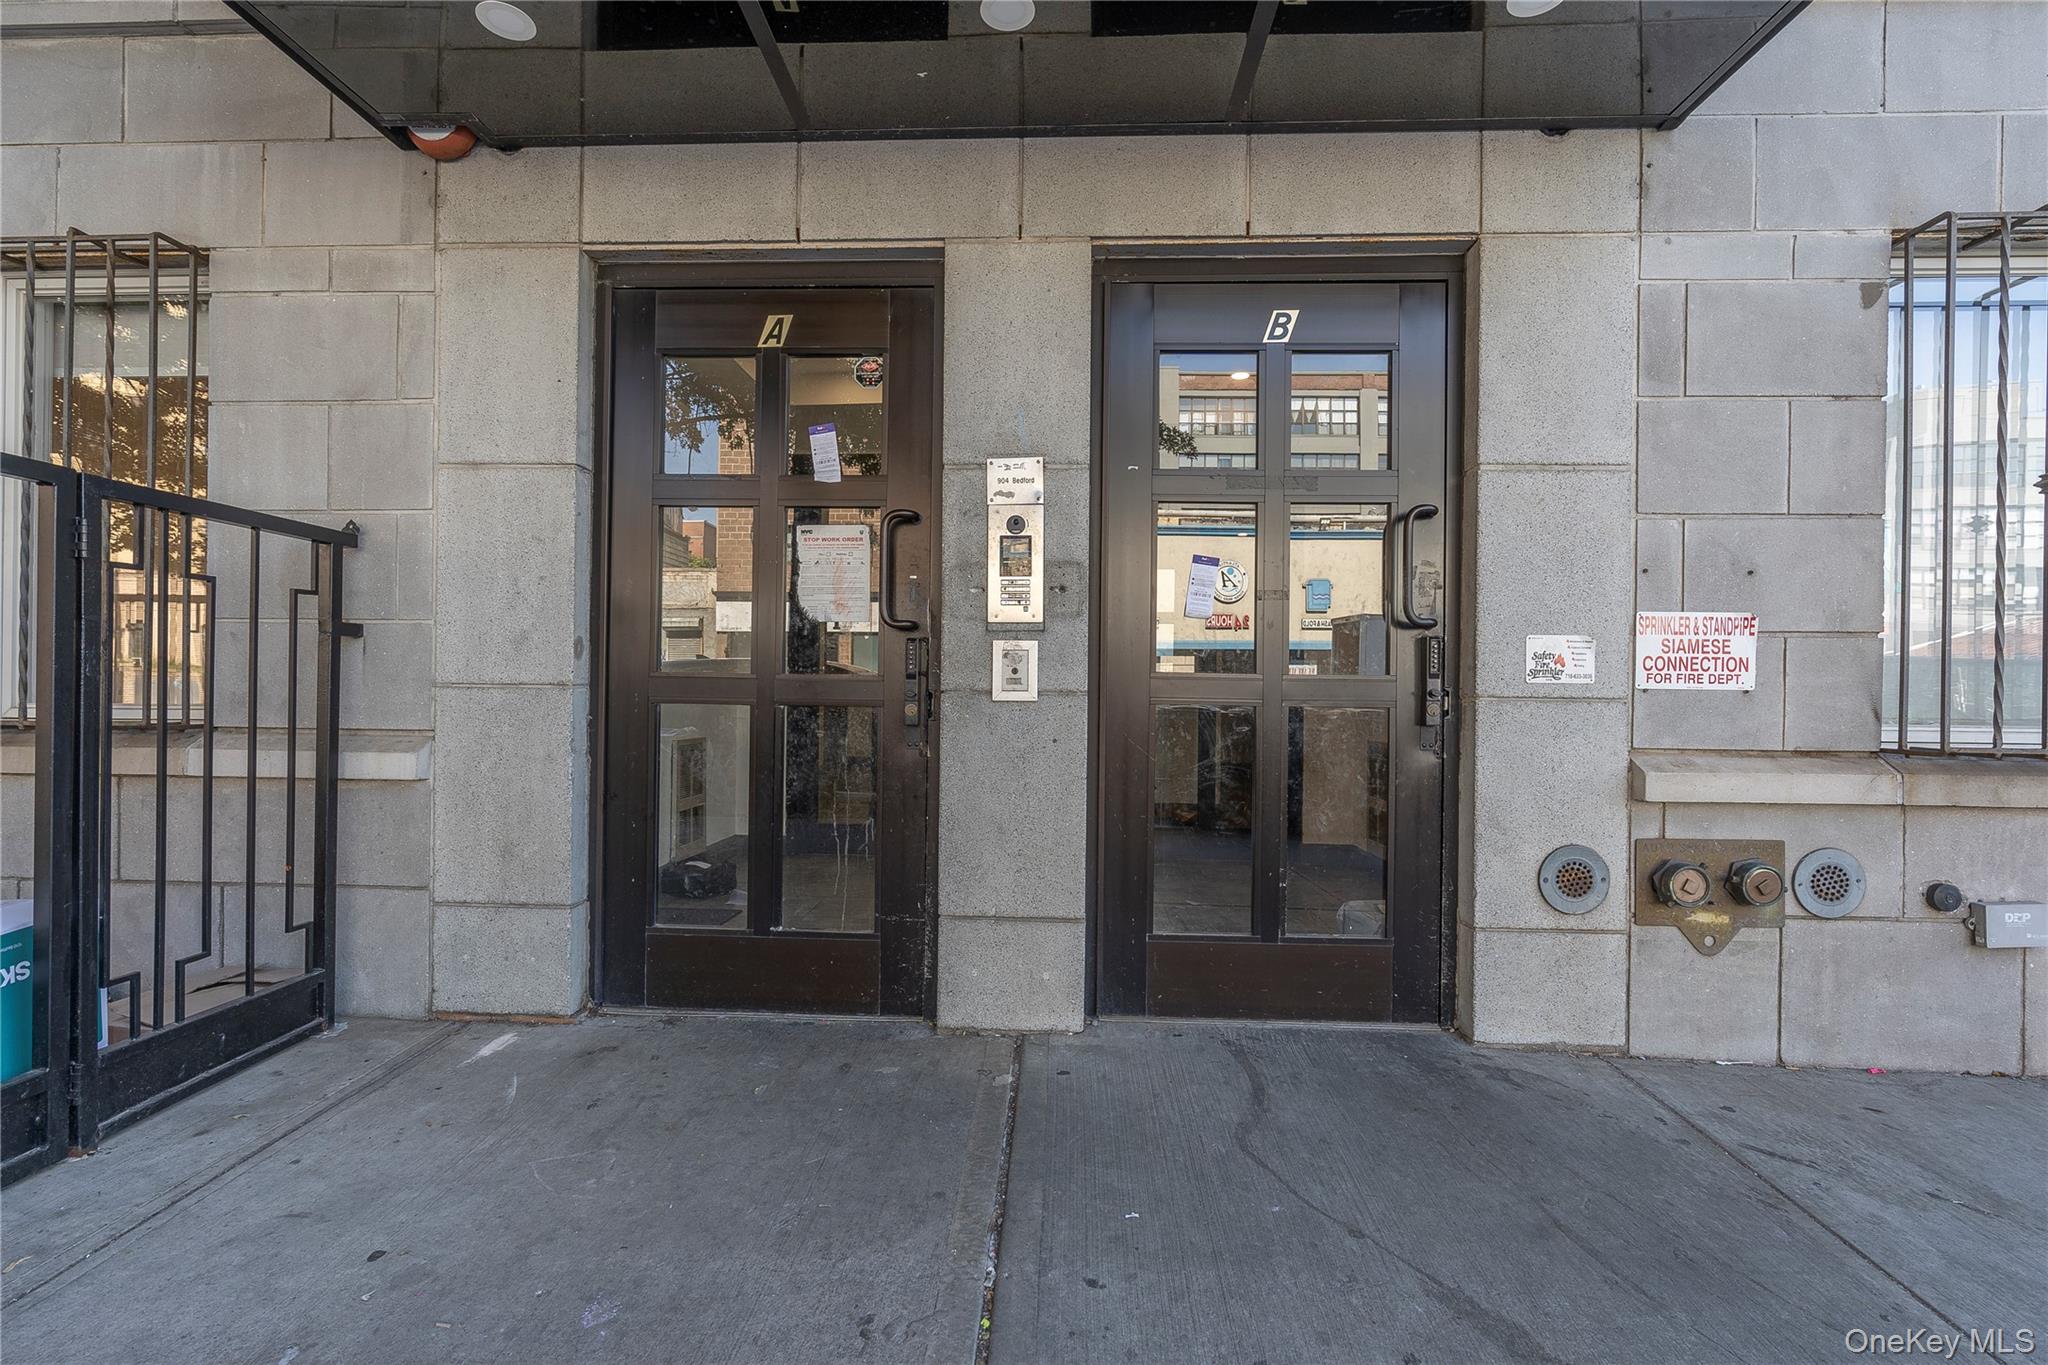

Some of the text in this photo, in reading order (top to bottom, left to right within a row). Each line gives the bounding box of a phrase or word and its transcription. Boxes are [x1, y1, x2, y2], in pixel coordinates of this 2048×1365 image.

[762, 317, 785, 345] A
[1267, 312, 1292, 340] B
[997, 477, 1009, 485] 904
[1638, 616, 1756, 636] SPRINKLER & STANDPIPE
[1661, 638, 1731, 654] SIAMESE
[1532, 650, 1556, 662] Safety
[1534, 660, 1550, 668] Fire
[1643, 656, 1749, 672] CONNECTION
[1527, 667, 1564, 679] Sprinkler
[1646, 673, 1745, 684] FOR FIRE DEPT.
[2004, 912, 2031, 923] DEP
